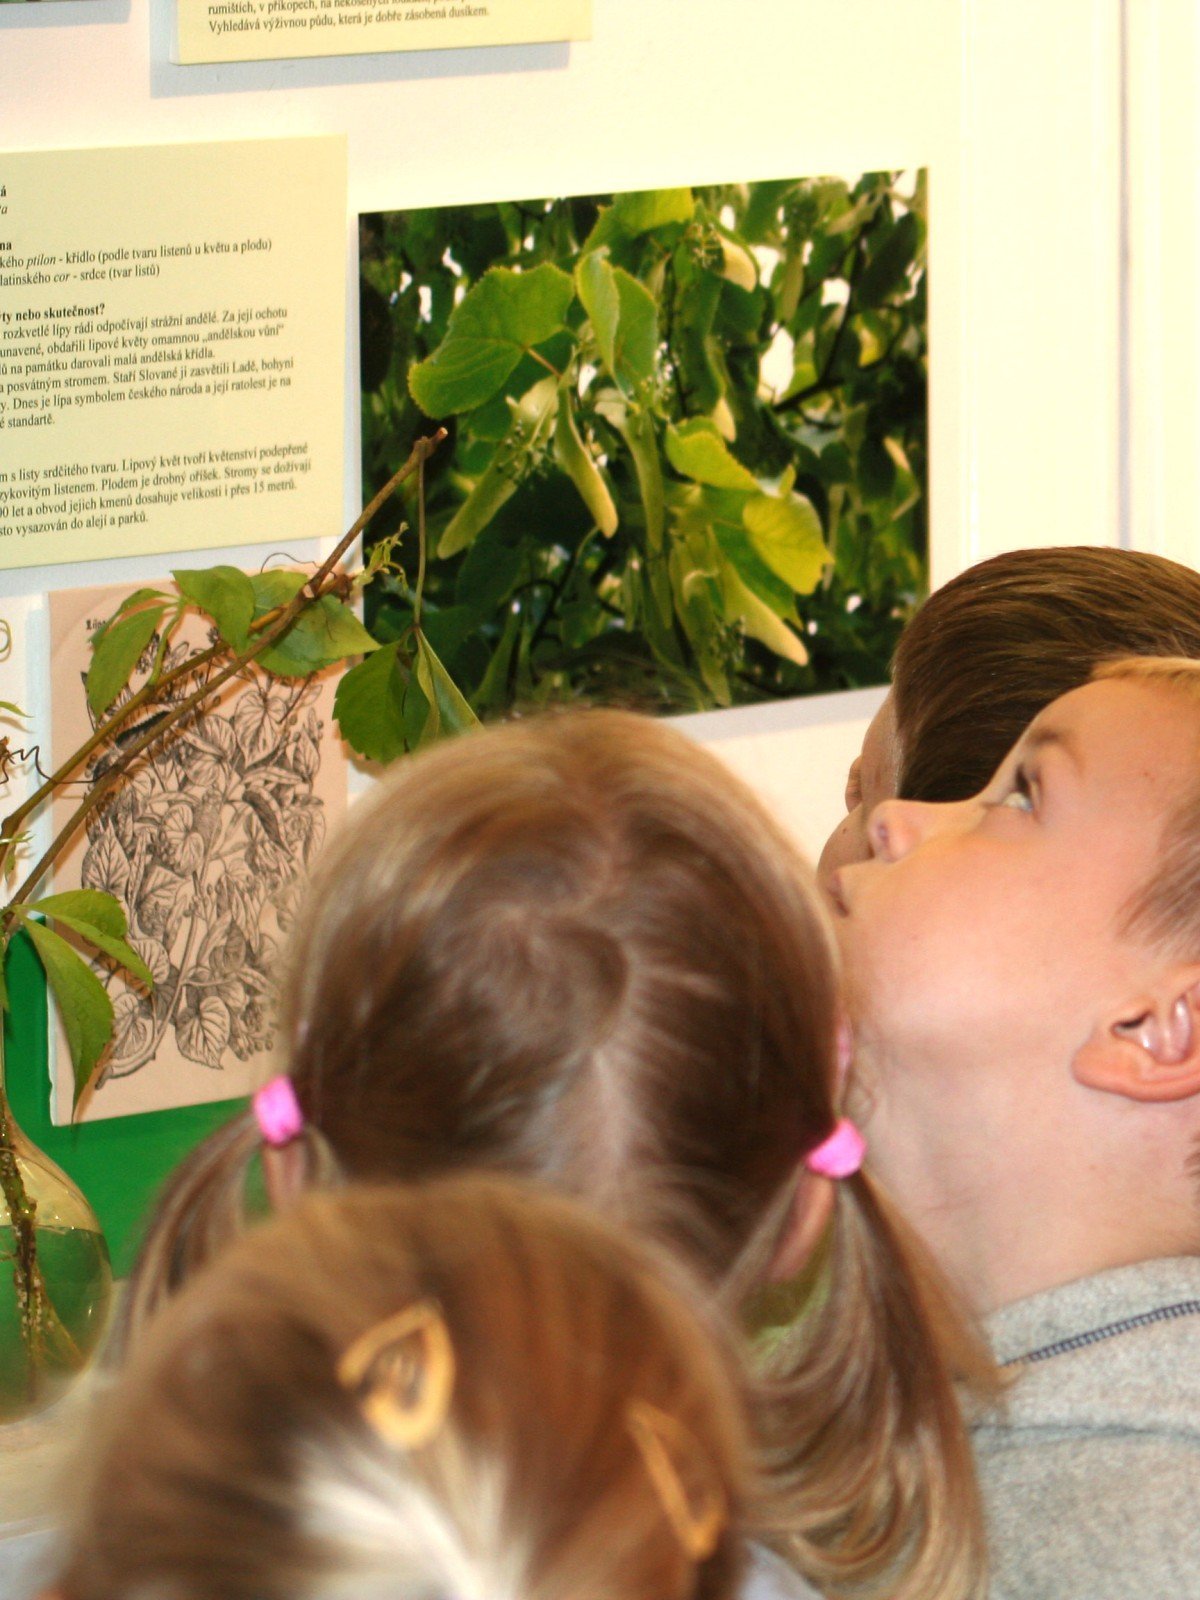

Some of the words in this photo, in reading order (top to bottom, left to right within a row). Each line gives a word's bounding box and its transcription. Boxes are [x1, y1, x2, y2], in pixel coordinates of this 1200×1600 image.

[209, 18, 260, 35] Vyhledává
[263, 17, 307, 32] výživnou
[309, 14, 337, 29] půdu,
[339, 12, 361, 25] která
[364, 12, 373, 25] je
[375, 10, 401, 22] dobře
[405, 8, 446, 21] zásobená
[449, 5, 489, 18] dusíkem.
[259, 4, 265, 12] v
[26, 253, 56, 269] ptilon
[65, 251, 95, 264] křídlo
[98, 249, 129, 265] (podle
[132, 249, 157, 259] tvaru
[160, 243, 192, 257] listenů
[195, 246, 201, 255] u
[203, 242, 230, 254] květu
[232, 243, 238, 252] a
[241, 238, 272, 254] plodu)
[0, 272, 51, 286] latinského
[54, 273, 70, 282] cor
[80, 268, 106, 280] srdce
[108, 267, 132, 281] (tvar
[135, 264, 160, 277] listů)
[0, 312, 12, 325] ty
[16, 309, 41, 321] nebo
[44, 303, 105, 319] skutečnost?
[3, 325, 49, 339] rozkvetlé
[52, 324, 71, 339] lípy
[74, 322, 93, 334] rádi
[97, 317, 148, 334] odpočívají
[150, 314, 183, 328] strážní
[185, 312, 219, 325] andělé.
[222, 310, 235, 322] Za
[237, 308, 253, 324] její
[255, 307, 288, 319] ochotu
[47, 340, 86, 354] obdařili
[89, 339, 119, 353] lipové
[122, 336, 148, 349] květy
[152, 333, 200, 345] omamnou
[7, 377, 61, 395] posvátným
[64, 376, 109, 387] stromem.
[113, 371, 136, 384] Staří
[139, 367, 177, 381] Slované
[180, 366, 187, 381] ji
[190, 362, 230, 377] zasvětili
[232, 360, 259, 373] Ladě,
[261, 357, 294, 371] bohyni
[11, 365, 23, 374] na
[25, 359, 68, 375] památku
[71, 355, 111, 370] darovali
[114, 353, 137, 365] malá
[140, 349, 182, 364] andělská
[185, 347, 215, 359] křídla.
[13, 397, 38, 410] Dnes
[40, 396, 50, 410] je
[53, 395, 72, 409] lípa
[74, 390, 125, 407] symbolem
[128, 386, 167, 400] českého
[170, 383, 202, 396] národa
[205, 384, 211, 393] a
[212, 381, 229, 395] její
[231, 377, 266, 391] ratolest
[268, 376, 277, 390] je
[280, 376, 291, 386] na
[8, 413, 55, 428] standartě.
[11, 473, 16, 481] s
[19, 469, 40, 482] listy
[43, 465, 89, 478] srdčitého
[91, 464, 118, 474] tvaru.
[122, 456, 157, 471] Lipový
[160, 454, 181, 467] květ
[183, 454, 206, 465] tvoří
[208, 447, 257, 463] květenství
[259, 442, 308, 460] podepřené
[54, 483, 97, 496] listenem.
[101, 478, 138, 491] Plodem
[140, 477, 150, 489] je
[153, 471, 186, 486] drobný
[190, 468, 220, 482] oříšek.
[224, 466, 257, 479] Stromy
[261, 465, 271, 474] se
[273, 458, 312, 473] dožívají
[12, 505, 24, 517] let
[27, 507, 33, 515] a
[36, 501, 67, 515] obvod
[68, 498, 97, 514] jejich
[100, 494, 133, 509] kmenů
[135, 491, 178, 506] dosahuje
[182, 485, 221, 501] velikosti
[224, 484, 228, 496] i
[231, 482, 250, 498] přes
[253, 481, 265, 493] 15
[267, 478, 297, 491] metrů.
[16, 519, 67, 537] vysazován
[71, 517, 83, 529] do
[86, 515, 107, 529] alejí
[109, 517, 115, 525] a
[118, 510, 148, 527] parků.
